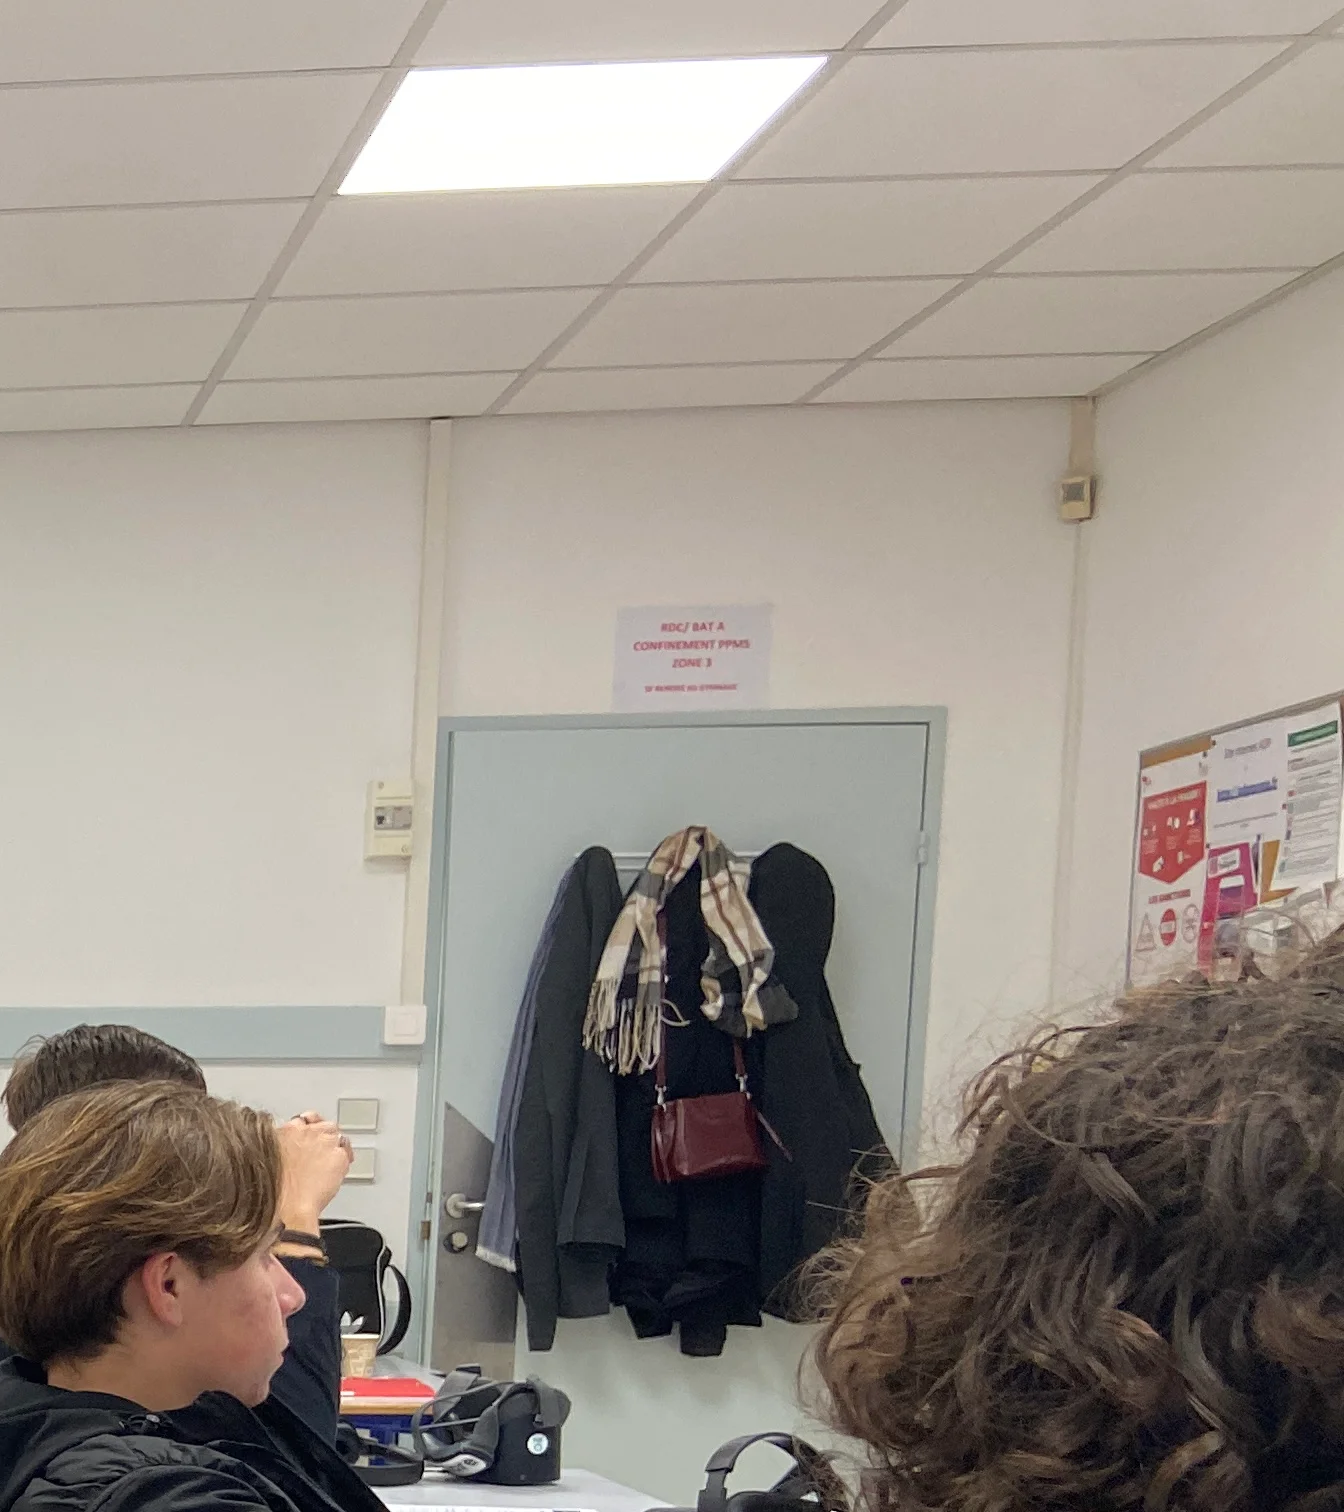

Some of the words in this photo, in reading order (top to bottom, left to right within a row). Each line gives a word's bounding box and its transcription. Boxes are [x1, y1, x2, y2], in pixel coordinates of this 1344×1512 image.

[692, 622, 713, 631] BAT
[633, 640, 715, 651] CONFINEMENT
[672, 658, 702, 668] ZONE
